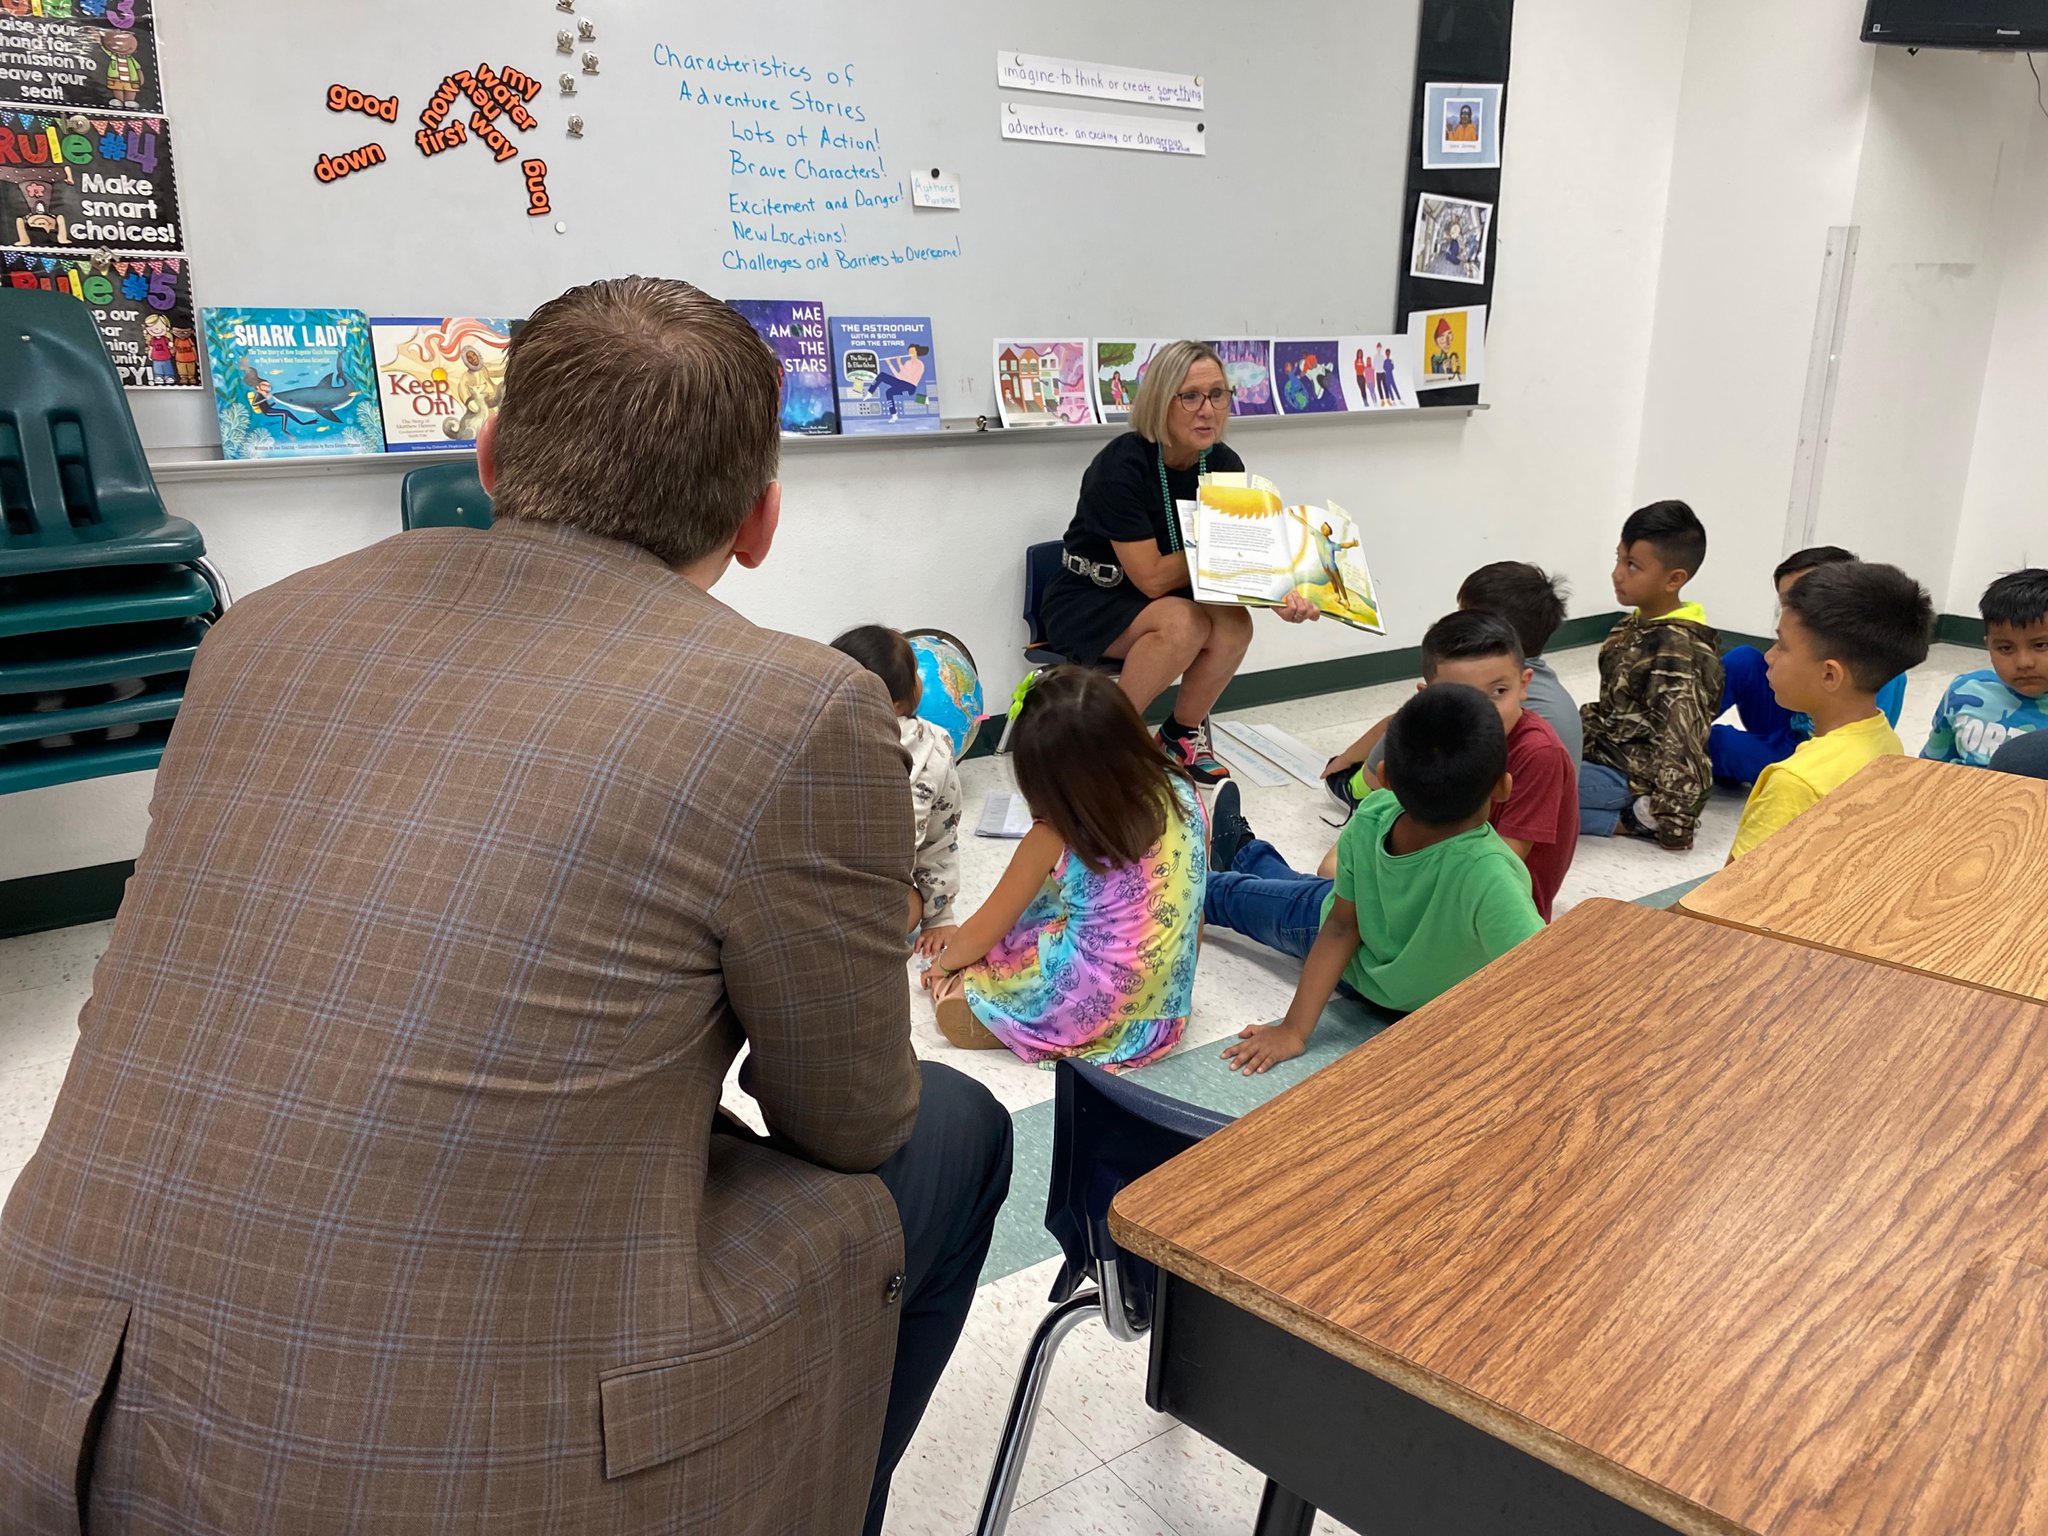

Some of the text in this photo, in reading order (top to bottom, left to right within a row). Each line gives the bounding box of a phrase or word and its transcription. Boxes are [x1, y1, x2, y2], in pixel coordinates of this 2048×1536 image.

[39, 23, 79, 37] your
[0, 67, 87, 87] eave your
[78, 56, 97, 71] to
[653, 42, 855, 88] Characteristics of
[20, 85, 64, 100] seat!
[476, 63, 538, 132] water
[502, 65, 542, 102] my
[1075, 67, 1103, 89] think
[1109, 80, 1118, 89] or
[1122, 81, 1152, 92] create
[1157, 84, 1202, 101] something
[327, 84, 398, 123] good
[420, 77, 460, 130] now
[679, 79, 866, 123] Adventure Stories
[0, 127, 158, 174] Rule #4
[415, 119, 467, 156] first
[469, 111, 518, 162] way
[731, 120, 882, 153] Lots of Action!
[1075, 129, 1087, 139] an
[1088, 130, 1118, 143] exciting
[1122, 134, 1132, 142] or
[1137, 132, 1183, 147] dangerous
[314, 143, 386, 183] down
[729, 149, 888, 181] Brave Characters!
[81, 173, 153, 196] Make
[521, 158, 552, 216] long
[729, 182, 904, 216] Excitement and Danger!
[81, 200, 158, 219] smart
[70, 220, 176, 243] choices!
[722, 235, 963, 273] Challenges and Barriers to Overcome!
[121, 272, 178, 311] #5
[110, 310, 139, 321] our
[792, 306, 822, 321] MAE
[841, 324, 925, 332] THE ASTRONAUT
[234, 324, 348, 348] SHARK LADY
[798, 341, 826, 356] THE
[785, 358, 827, 373] STARS
[389, 374, 449, 397] Keep
[412, 393, 455, 417] On!
